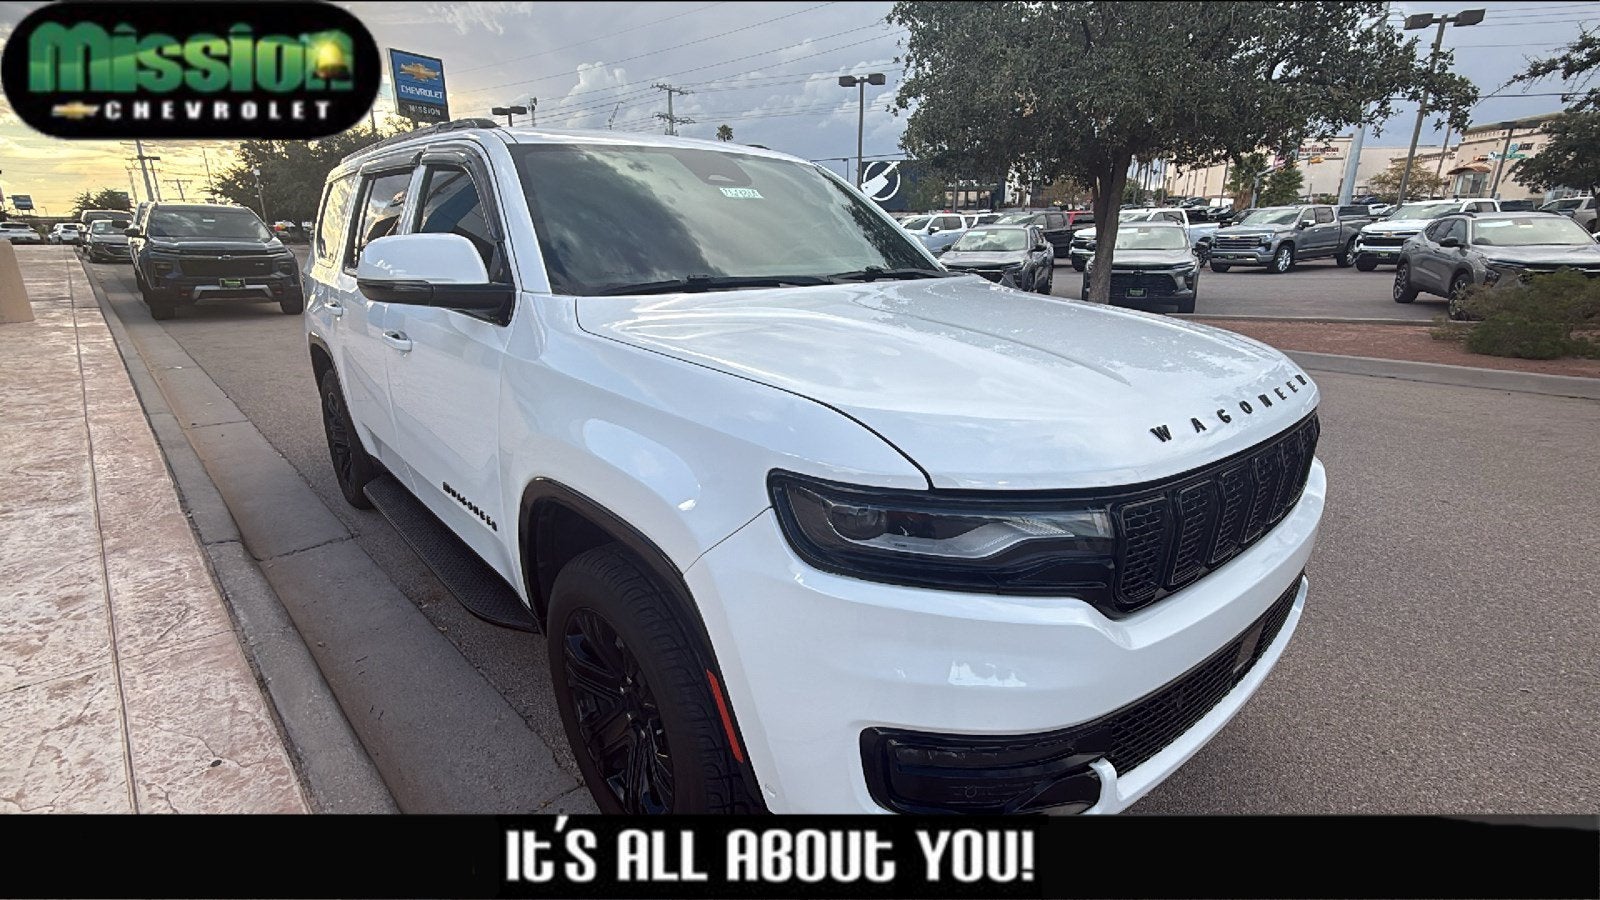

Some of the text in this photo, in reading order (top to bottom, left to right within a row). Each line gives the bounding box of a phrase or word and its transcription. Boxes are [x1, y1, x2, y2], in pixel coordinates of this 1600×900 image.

[400, 84, 444, 99] CHEVROLET
[408, 104, 441, 116] MISSION
[1149, 374, 1308, 443] WAGONEER
